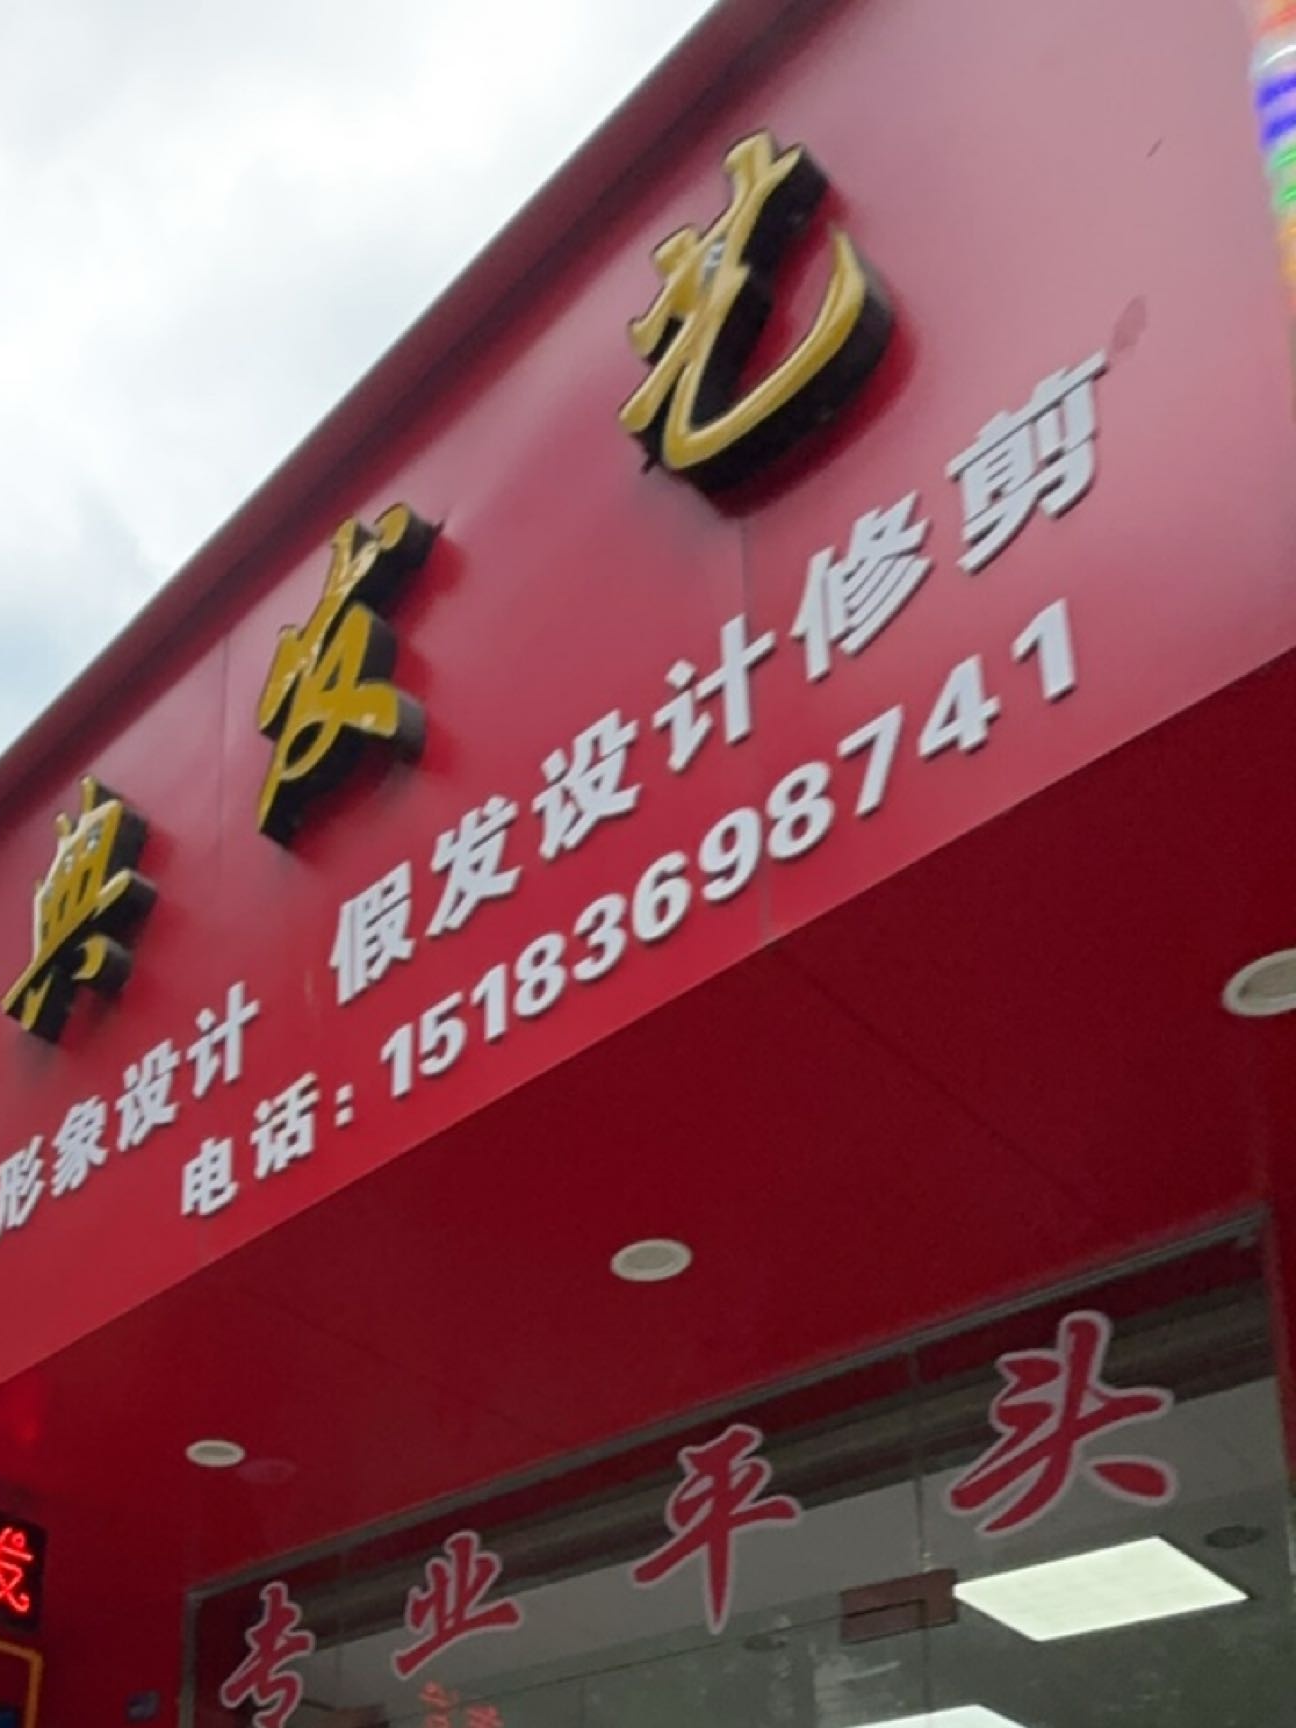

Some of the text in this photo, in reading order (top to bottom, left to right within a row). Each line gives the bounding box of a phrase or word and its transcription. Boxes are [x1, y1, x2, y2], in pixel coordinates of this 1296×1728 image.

[328, 350, 1107, 1004] 假发设计修剪
